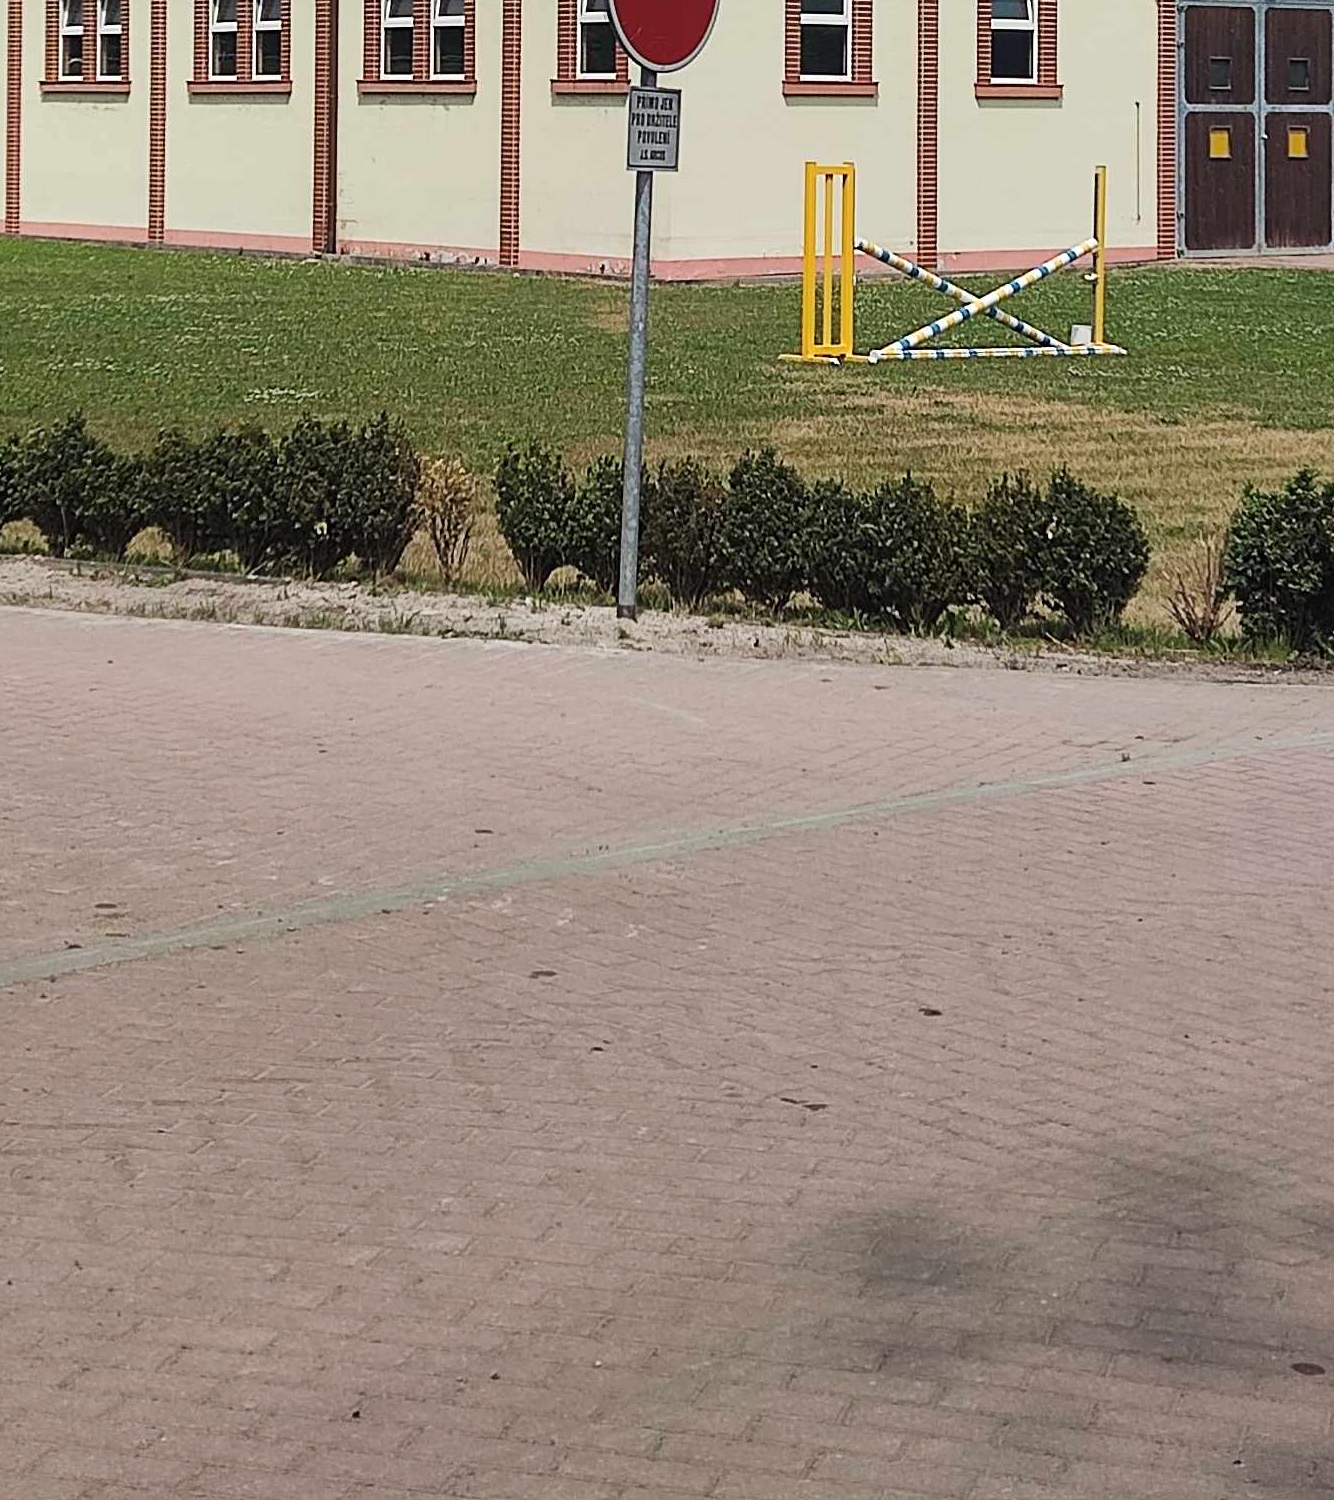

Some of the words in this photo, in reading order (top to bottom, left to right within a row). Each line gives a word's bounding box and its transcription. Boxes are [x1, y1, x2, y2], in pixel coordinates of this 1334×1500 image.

[660, 98, 673, 111] JEN
[631, 112, 645, 127] PRO
[647, 111, 677, 128] DRŽITELE
[637, 130, 670, 145] POVOLENÍ
